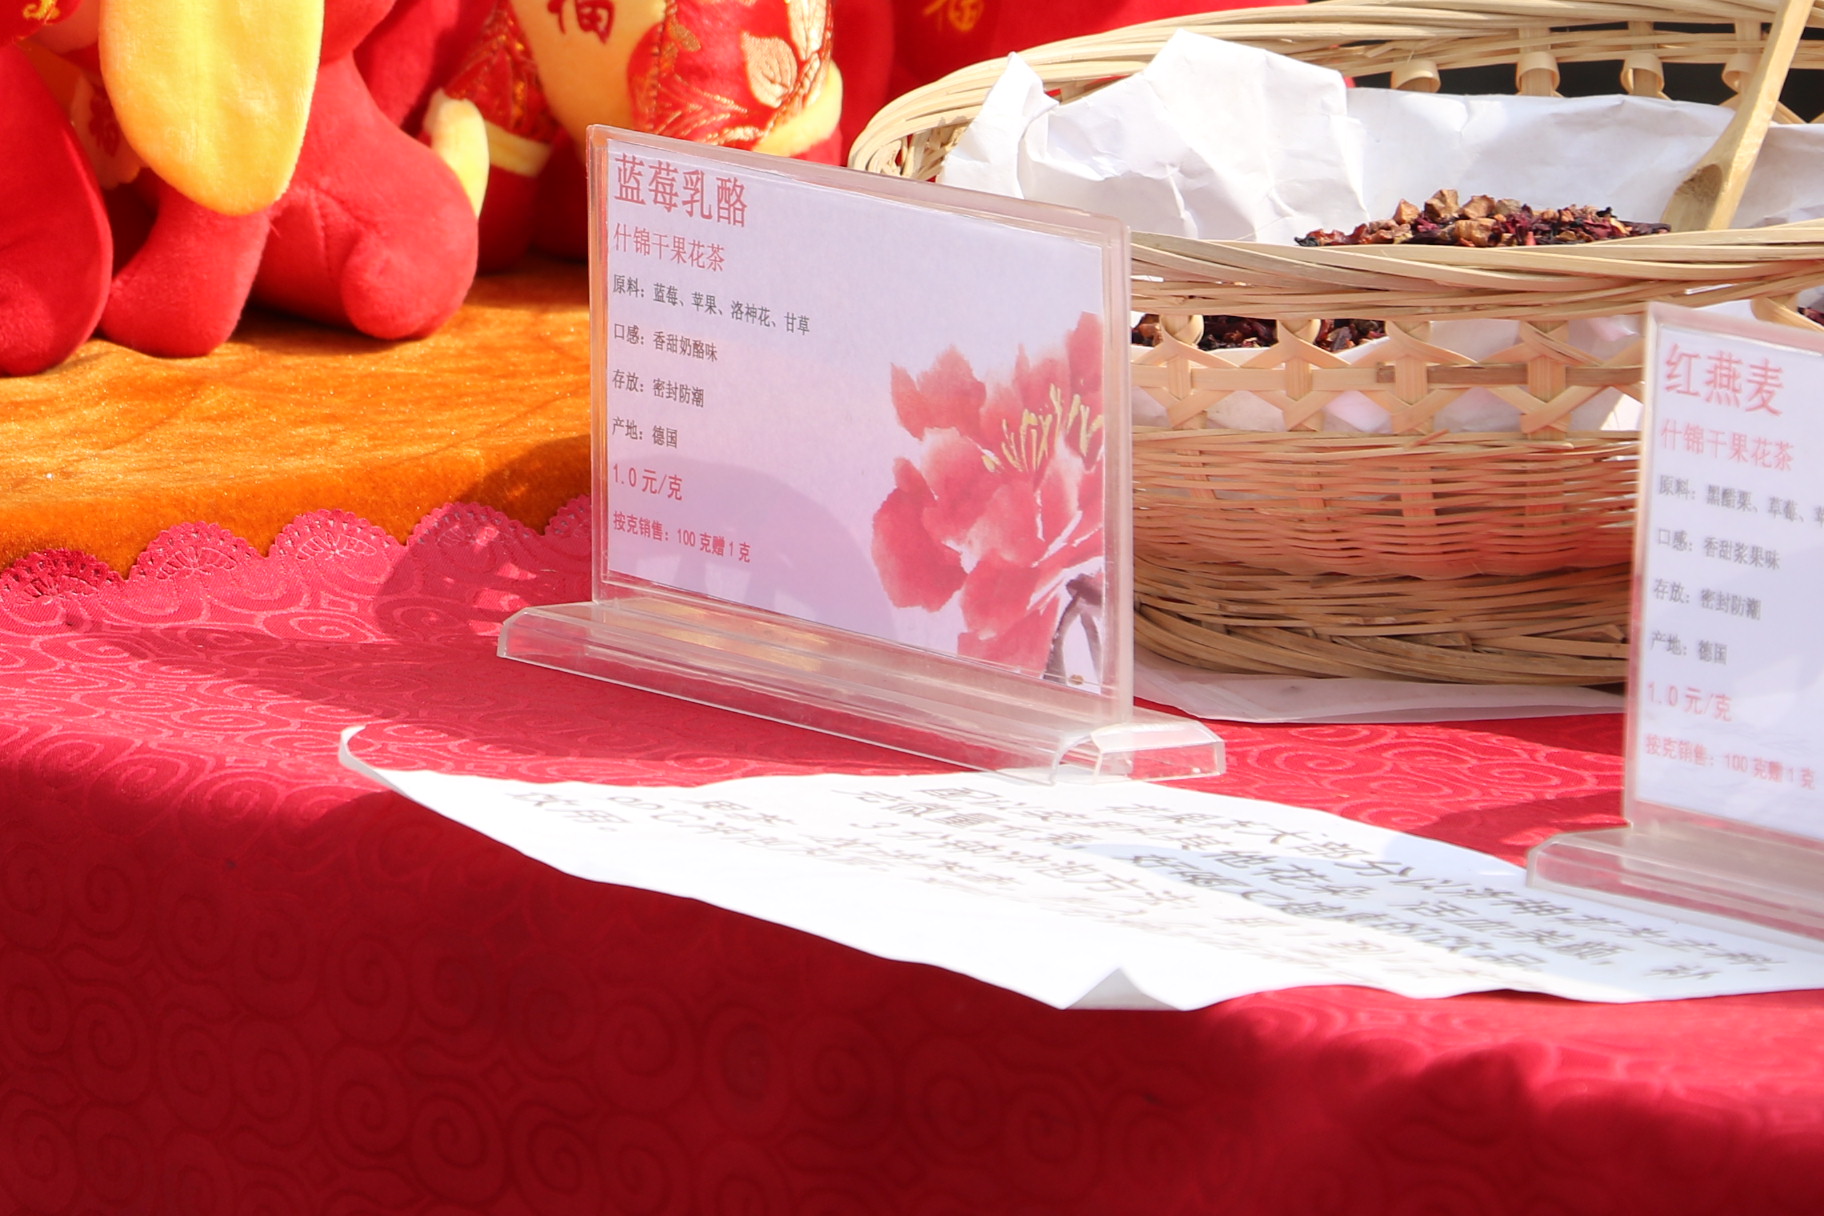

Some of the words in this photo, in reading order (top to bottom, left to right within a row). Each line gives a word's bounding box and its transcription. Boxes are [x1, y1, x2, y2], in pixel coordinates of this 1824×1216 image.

[614, 152, 748, 228] 蓝莓乳酪
[613, 222, 726, 272] 什锦干果花茶
[613, 323, 718, 362] 口感：香甜奶酪味
[612, 369, 705, 408] 存放：密封防潮
[1664, 343, 1784, 417] 红燕麦
[612, 416, 678, 448] 产地：德国
[1660, 418, 1795, 472] 什锦干果花茶
[1653, 578, 1762, 620] 存放：密封防潮
[1650, 630, 1728, 666] 产地：德国
